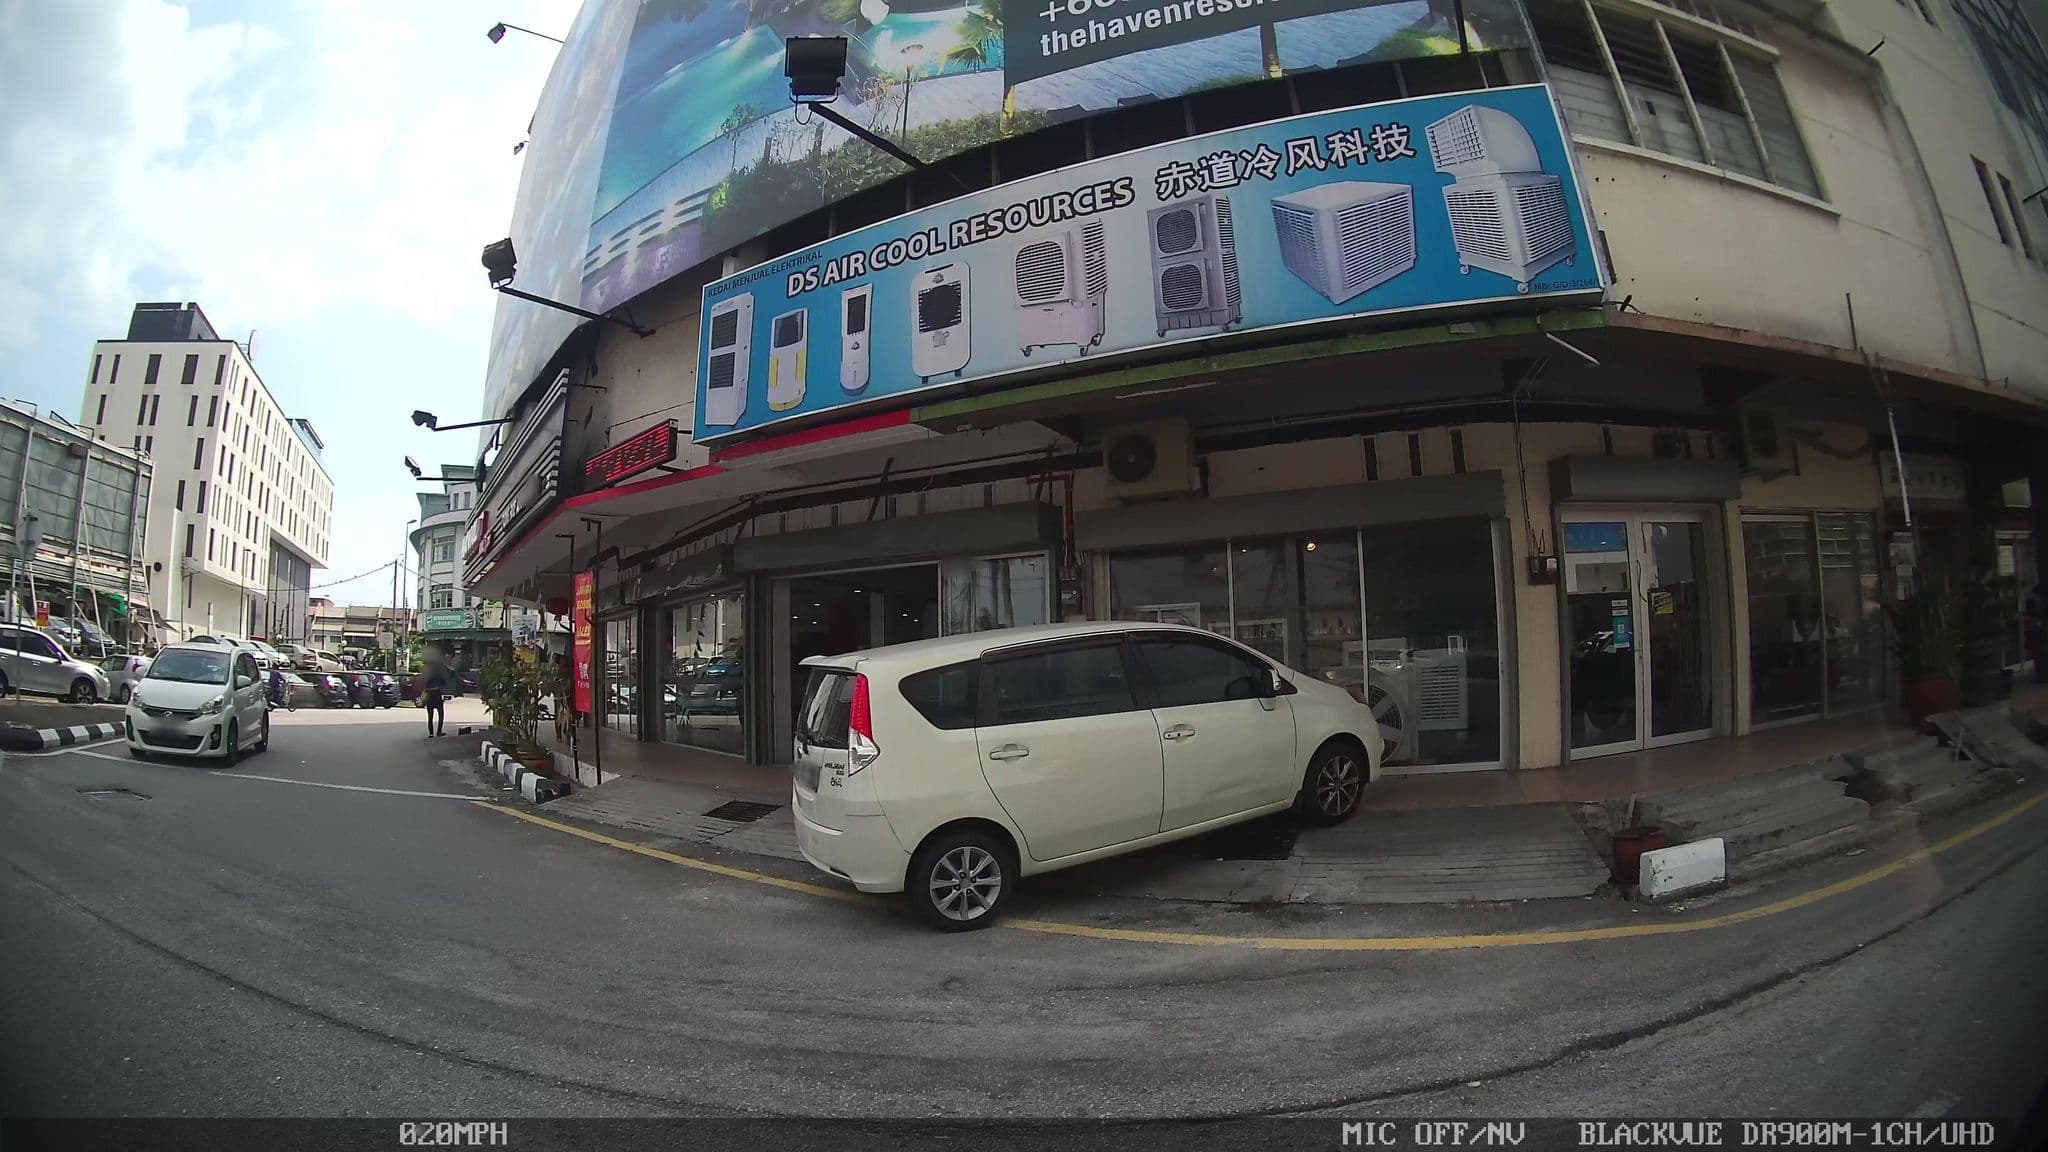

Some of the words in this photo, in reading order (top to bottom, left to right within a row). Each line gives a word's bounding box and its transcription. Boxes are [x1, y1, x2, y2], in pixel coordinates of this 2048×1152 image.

[1155, 123, 1416, 200] 赤道冷风科技
[707, 283, 732, 298] KEDAI
[732, 270, 770, 290] MENJUAL
[771, 249, 823, 274] ELEKTRIKAL
[787, 264, 820, 298] DS
[822, 251, 866, 288] AIR
[869, 228, 946, 271] COOL
[949, 177, 1136, 249] RESOURCES
